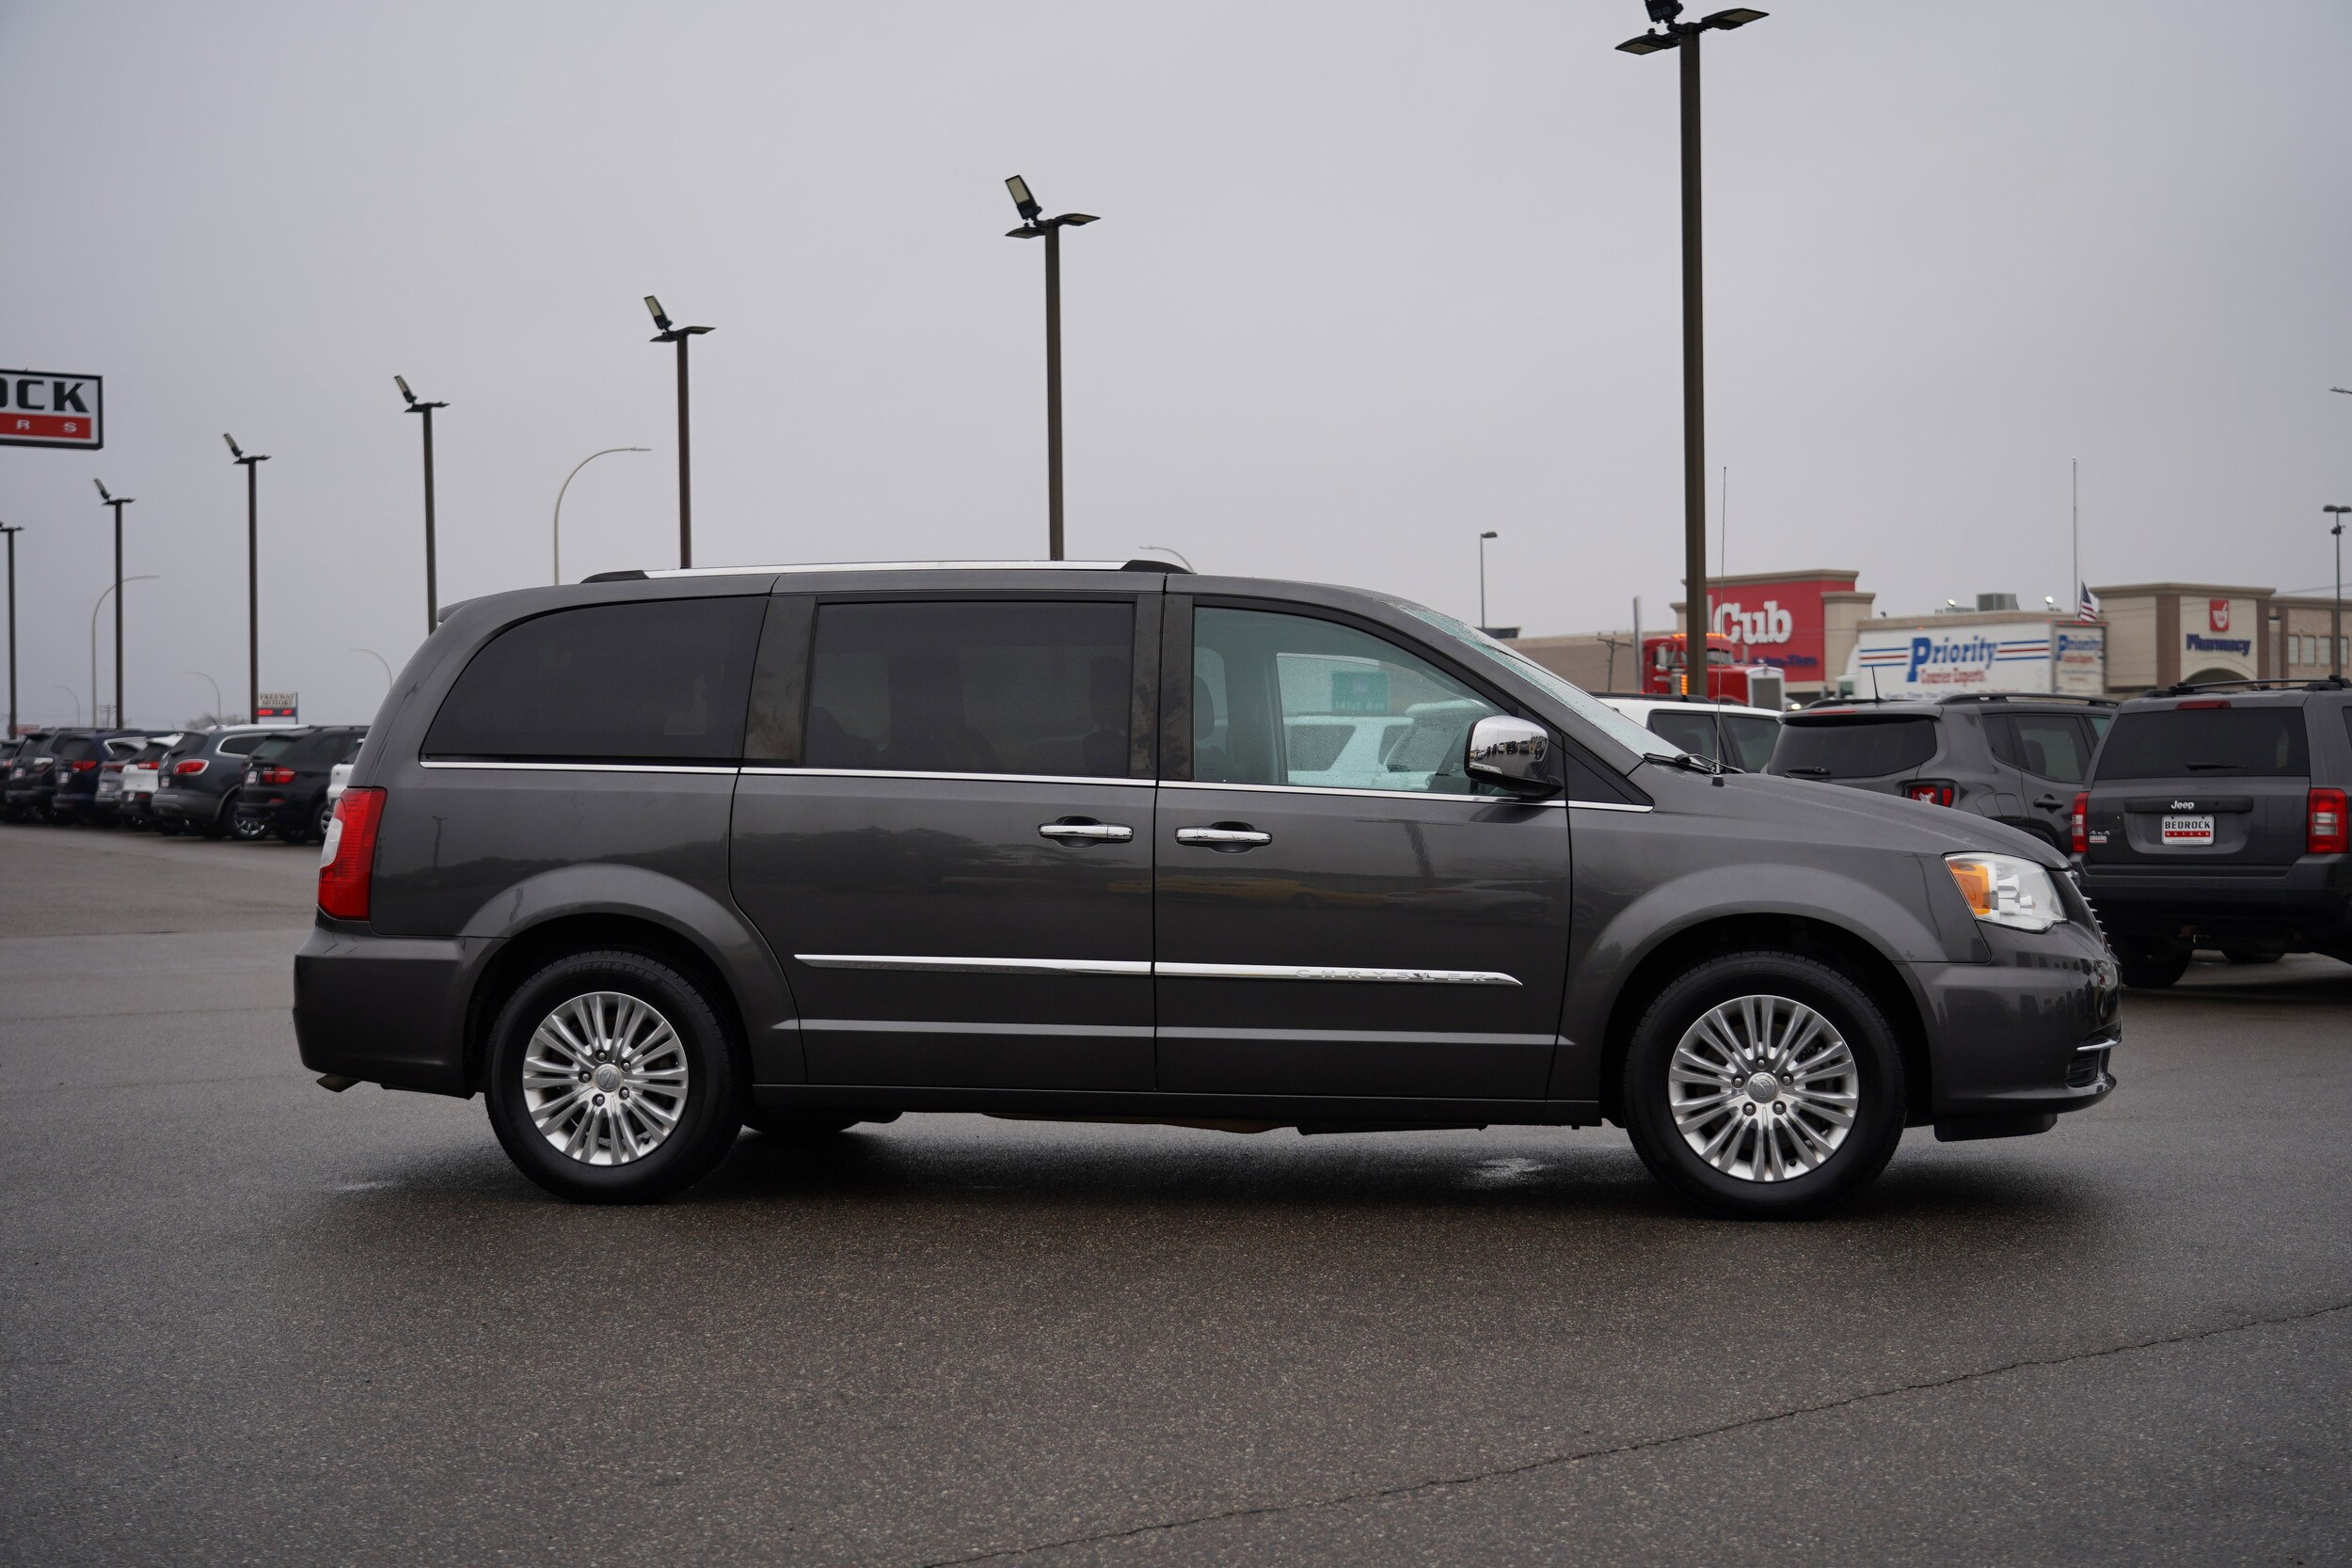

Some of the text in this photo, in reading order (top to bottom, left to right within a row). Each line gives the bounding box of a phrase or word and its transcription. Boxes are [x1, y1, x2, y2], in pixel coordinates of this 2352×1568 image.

[1713, 600, 1791, 644] Cub
[1906, 636, 1997, 682] Priority
[2185, 633, 2251, 656] Pharmacy
[2171, 800, 2195, 811] Jeep
